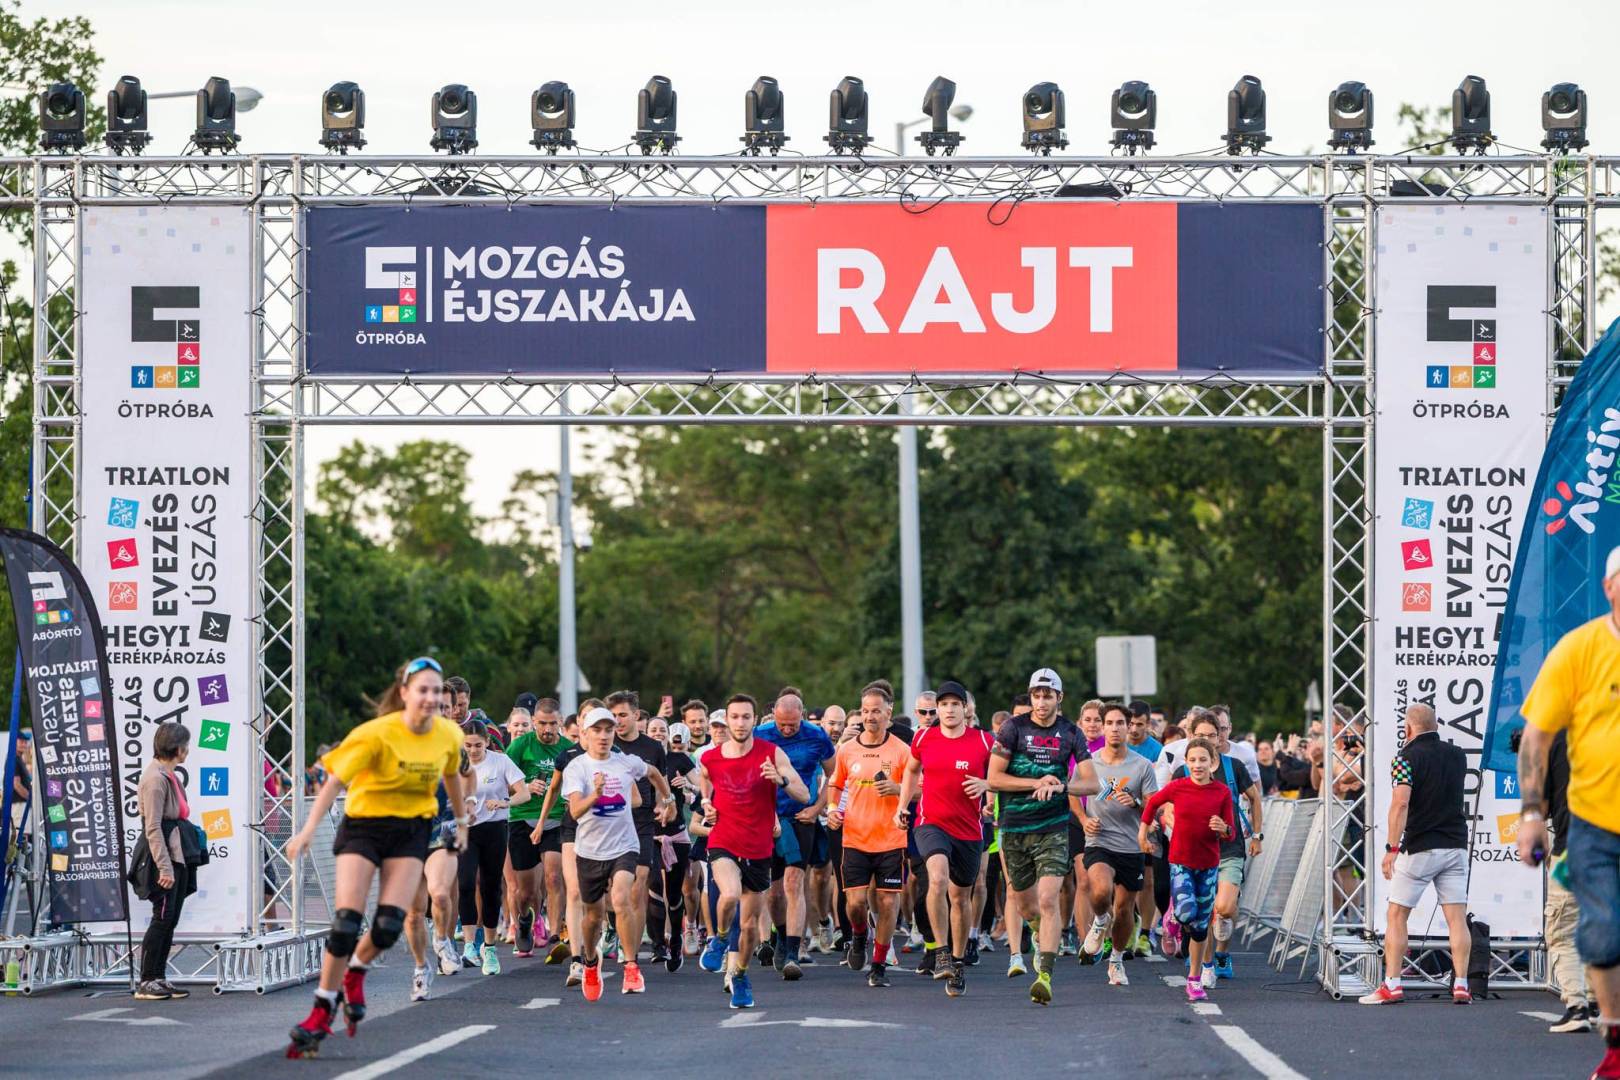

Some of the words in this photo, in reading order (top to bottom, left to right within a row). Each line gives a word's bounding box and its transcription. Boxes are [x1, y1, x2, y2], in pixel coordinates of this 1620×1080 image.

[444, 236, 625, 279] MOZGÁS
[444, 280, 695, 322] ÉJSZAKÁJA
[817, 247, 1133, 334] RAJT
[356, 330, 426, 345] ÖTPRÓBA
[118, 400, 213, 418] ÖTPRÓBA
[1412, 400, 1510, 419] ÖTPRÓBA
[105, 467, 229, 485] TRIATLON
[1399, 467, 1526, 486] TRIATLON
[145, 493, 178, 616] EVEZÉS
[184, 494, 216, 605] ÚSZÁS
[1439, 494, 1474, 617] EVEZÉS
[1479, 495, 1512, 607] ÚSZÁS
[102, 625, 190, 647] HEGYI
[1395, 627, 1485, 649] HEGYI
[106, 648, 226, 664] KERÉKPÁROZÁS
[119, 676, 142, 818] GYALOGLÁS
